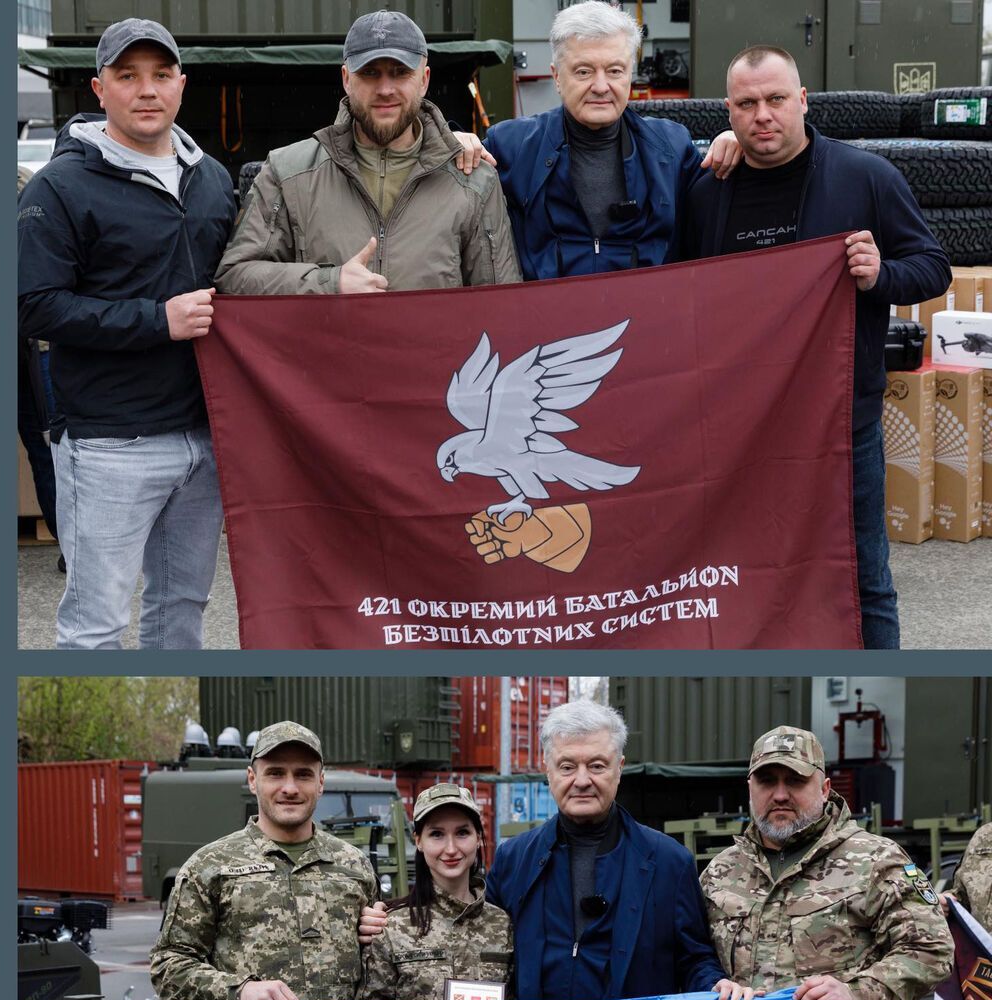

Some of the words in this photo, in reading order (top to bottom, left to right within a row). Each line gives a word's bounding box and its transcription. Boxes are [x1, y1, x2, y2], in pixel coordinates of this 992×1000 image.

[736, 224, 797, 240] САПСАН
[358, 596, 402, 617] 421
[407, 595, 557, 620] ОКРЕМИЙ
[564, 565, 739, 615] БАТАЛЬЙОН
[382, 621, 596, 646] БЕЗПІЛОТНИХ
[601, 597, 719, 634] СИСТЕМ
